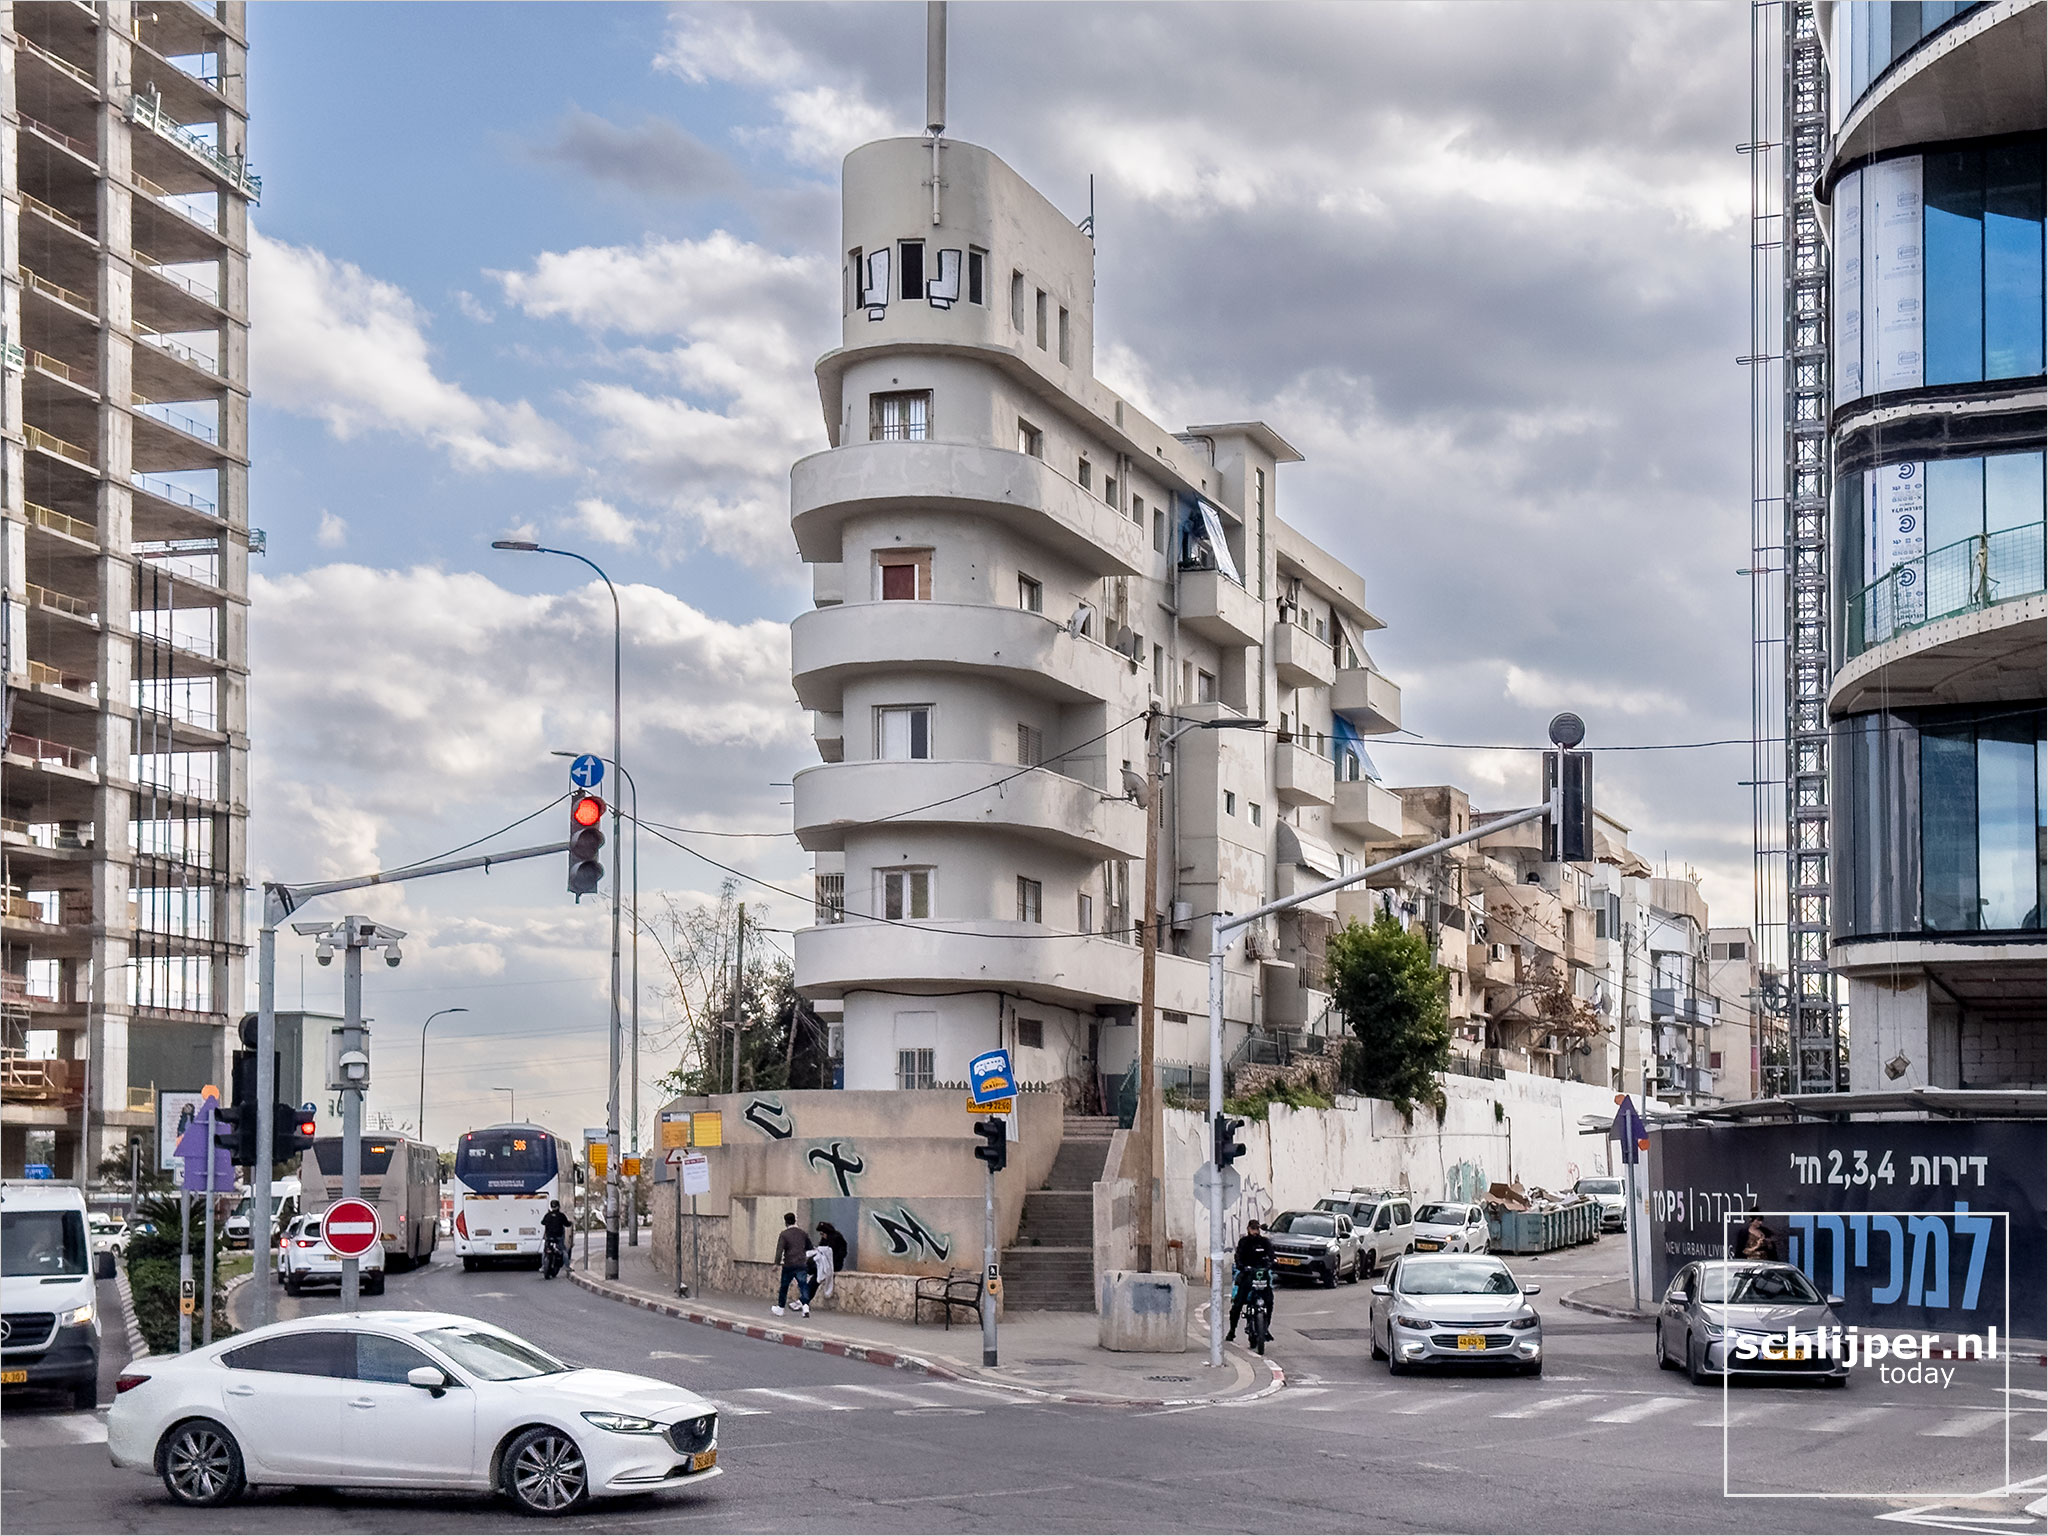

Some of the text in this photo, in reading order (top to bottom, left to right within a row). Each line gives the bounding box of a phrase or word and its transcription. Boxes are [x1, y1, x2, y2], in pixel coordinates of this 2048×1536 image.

[513, 1139, 527, 1151] 506
[1827, 1149, 1895, 1191] 2,3,4
[1910, 1155, 1989, 1186] דירות
[1652, 1190, 1685, 1222] TOP5
[1665, 1241, 1680, 1255] NEW
[1682, 1242, 1706, 1256] URBAN
